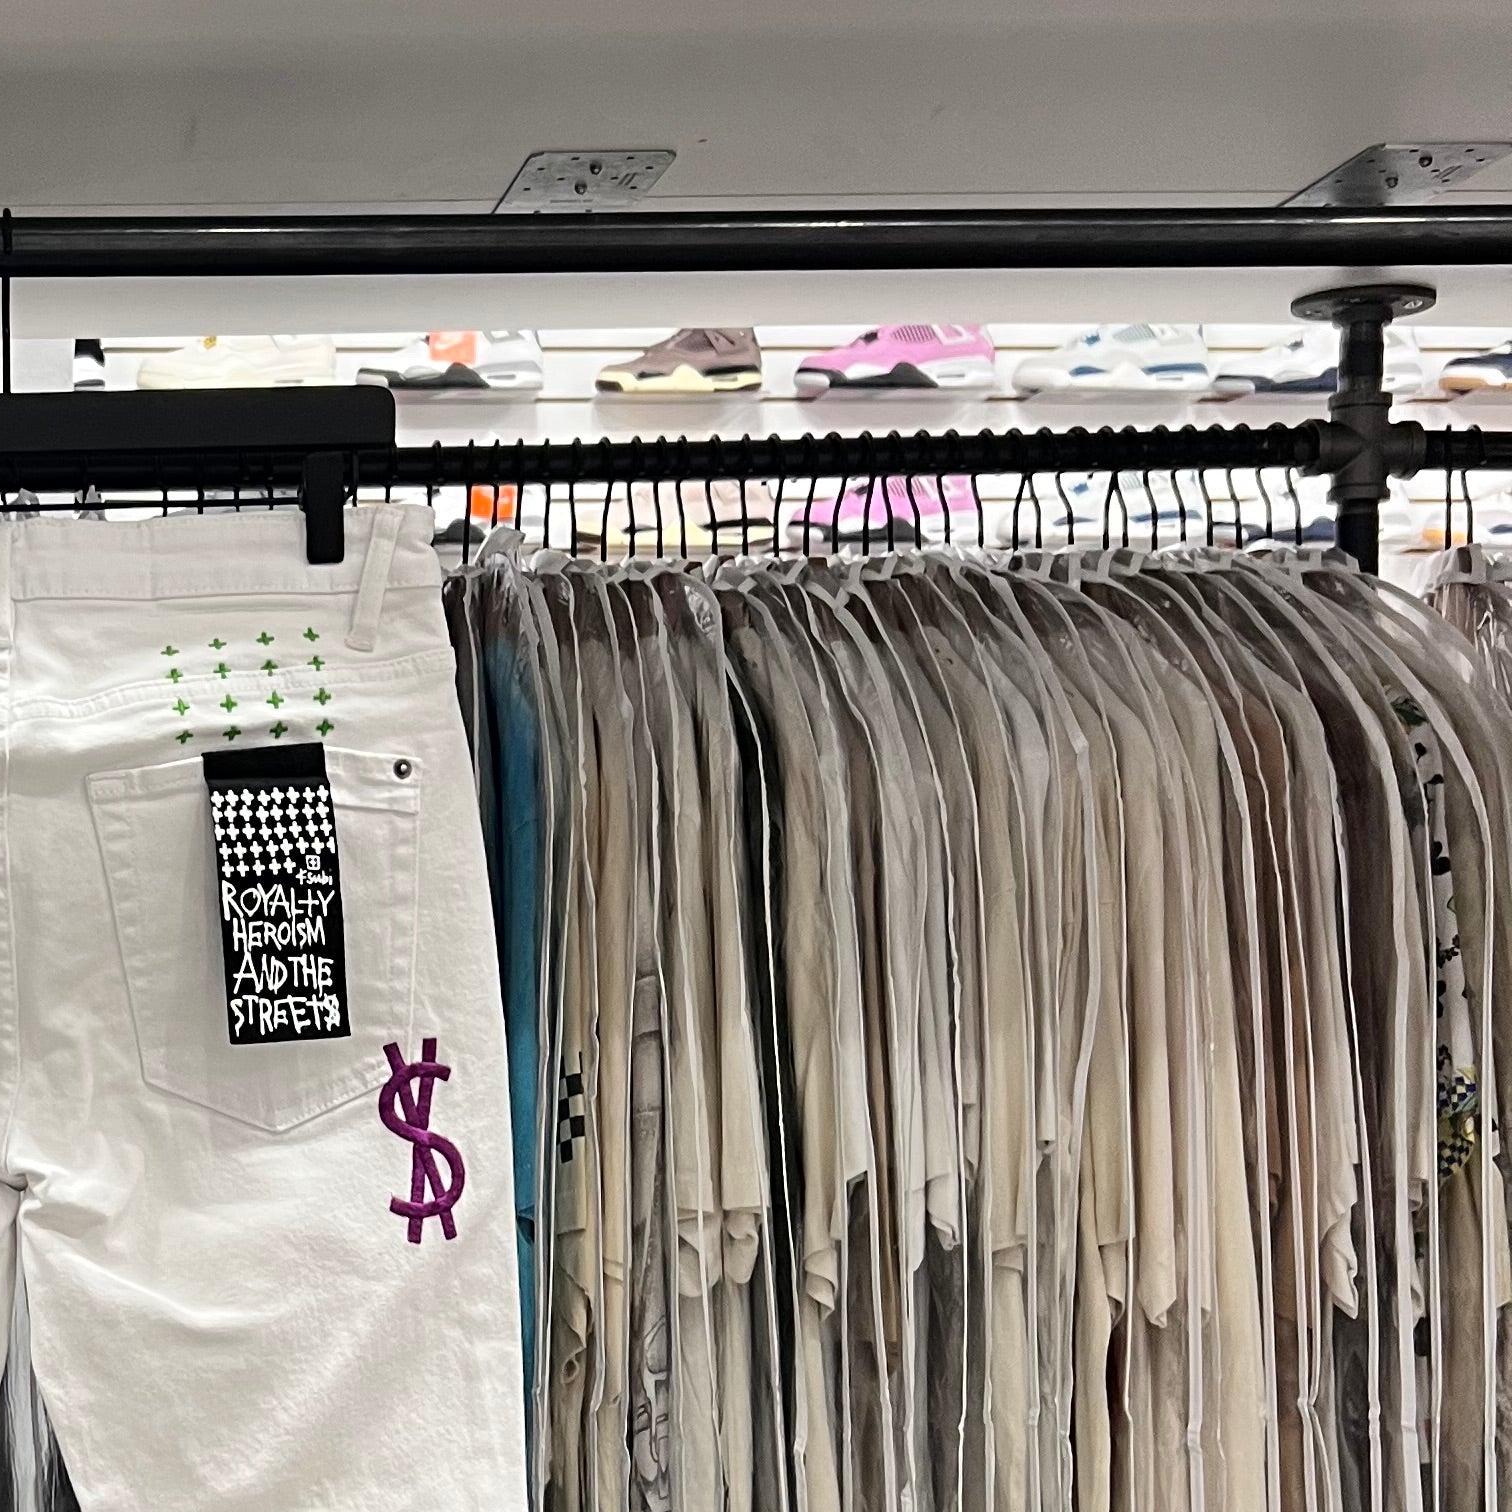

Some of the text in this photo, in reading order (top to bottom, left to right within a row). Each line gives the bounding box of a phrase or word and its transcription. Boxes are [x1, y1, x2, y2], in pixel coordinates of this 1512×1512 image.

[221, 880, 335, 920] ROYALTY
[232, 915, 325, 951] HEROISM
[233, 951, 334, 997] AND THE
